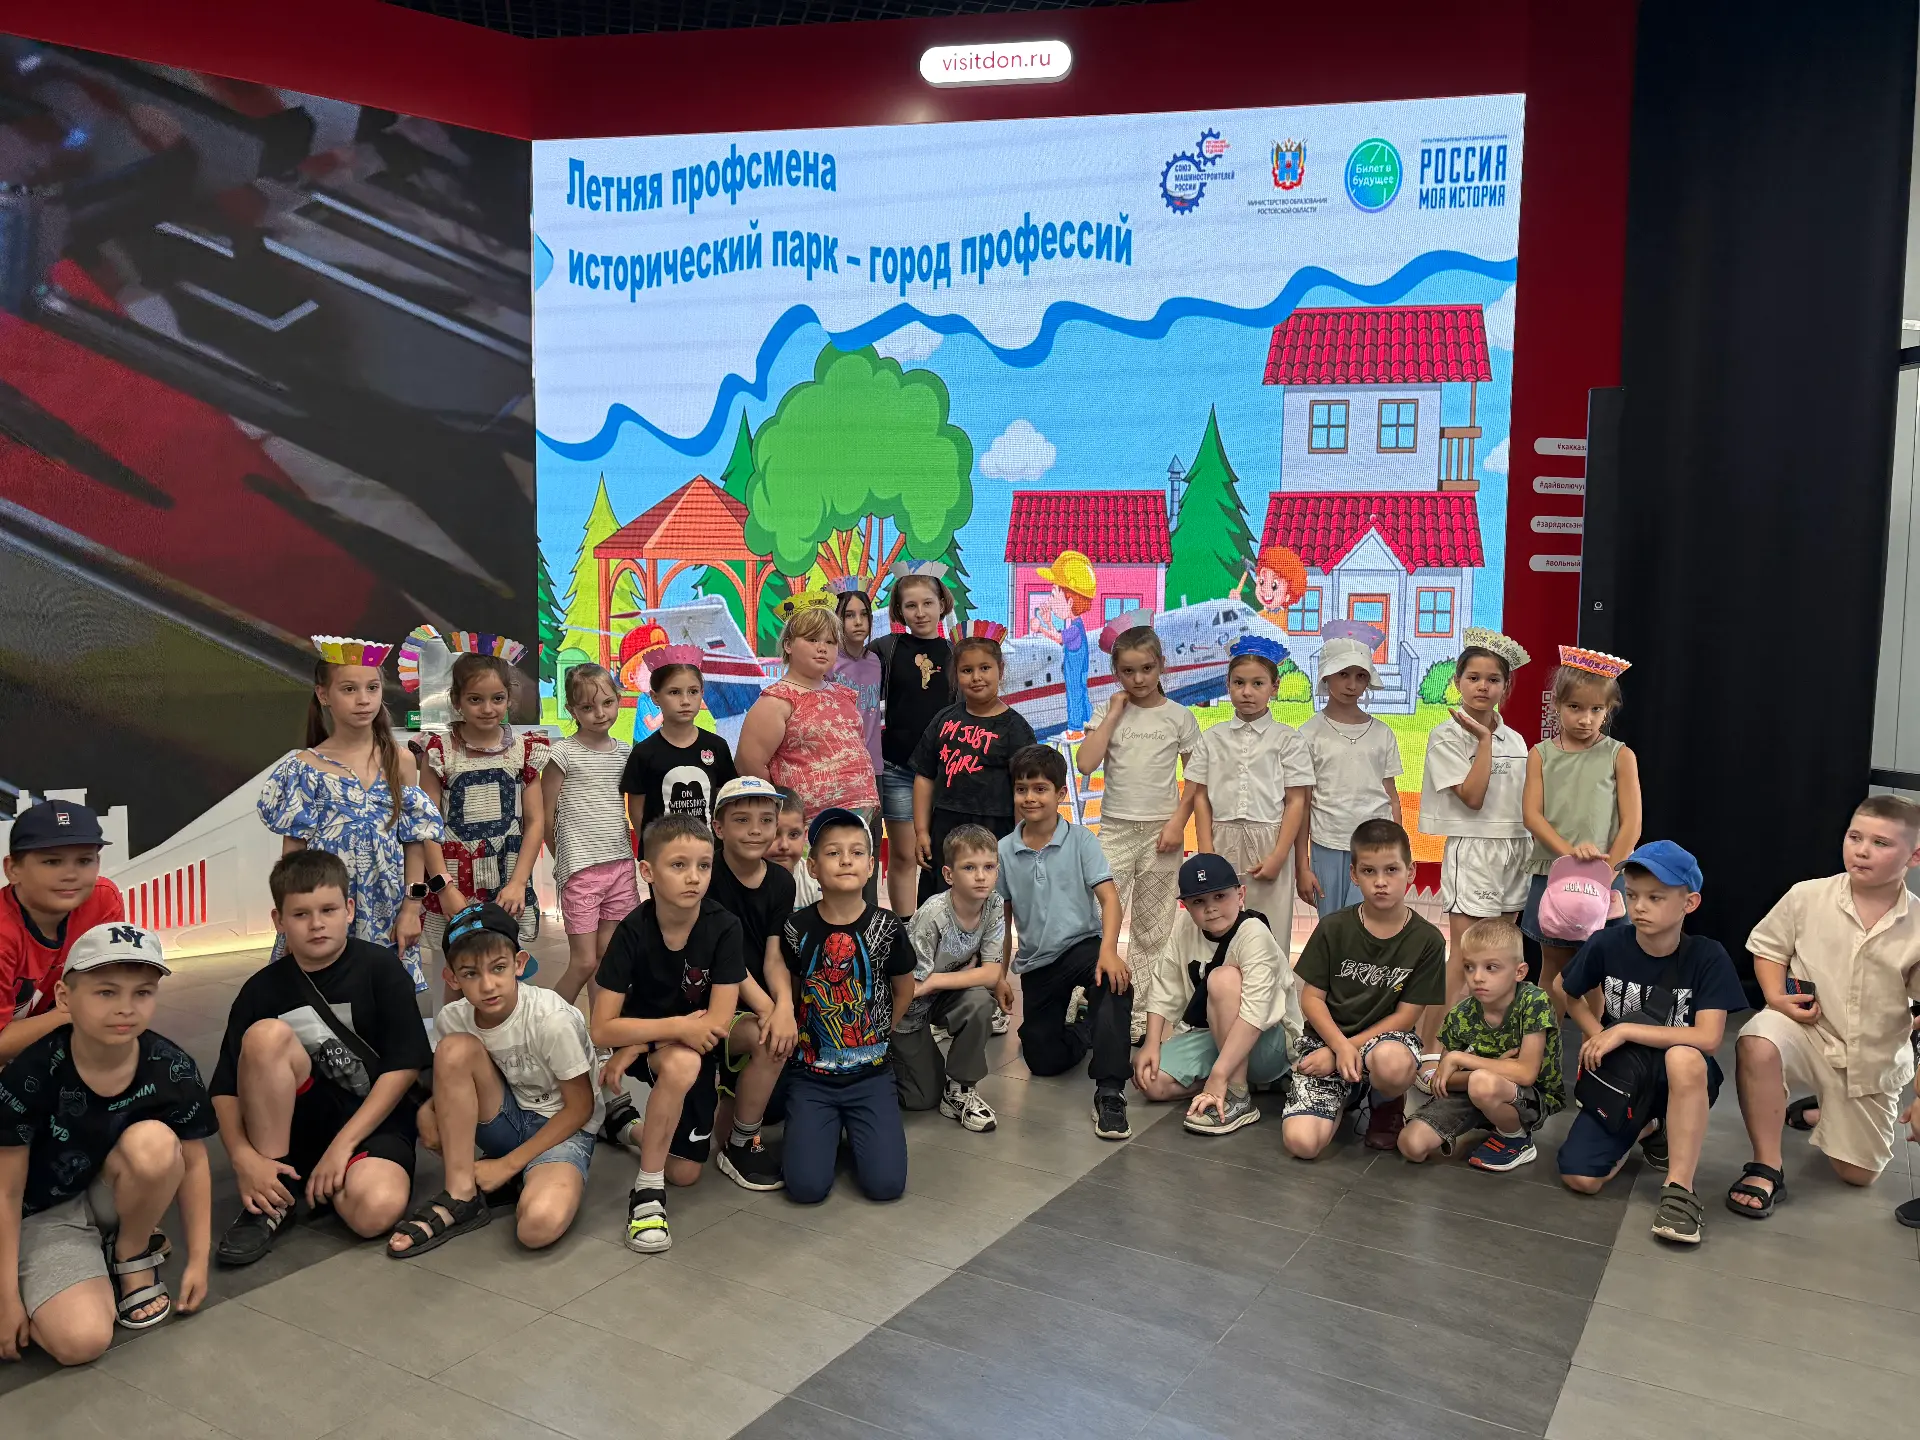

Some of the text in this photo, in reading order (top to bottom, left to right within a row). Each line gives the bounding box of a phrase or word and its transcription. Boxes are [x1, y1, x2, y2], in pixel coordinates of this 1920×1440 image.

[942, 50, 1051, 71] visitdon.ru
[1174, 163, 1192, 172] СОЮЗ
[1355, 163, 1392, 173] Билет в
[1419, 144, 1508, 185] РОССИЯ
[566, 143, 837, 215] Летняя профсмена
[1174, 183, 1197, 192] РОССИИ
[1352, 175, 1395, 188] будущее
[1419, 185, 1506, 210] МОЯ ИСТОРИЯ
[568, 218, 762, 303] исторический
[772, 230, 839, 281] парк
[869, 242, 951, 297] город
[961, 211, 1132, 284] профессий
[1536, 520, 1583, 530] #зарядисьэн
[957, 725, 999, 755] JUST
[1121, 726, 1166, 742] Romantic
[945, 748, 984, 788] GIRL
[681, 790, 693, 799] ON
[107, 926, 146, 949] NY
